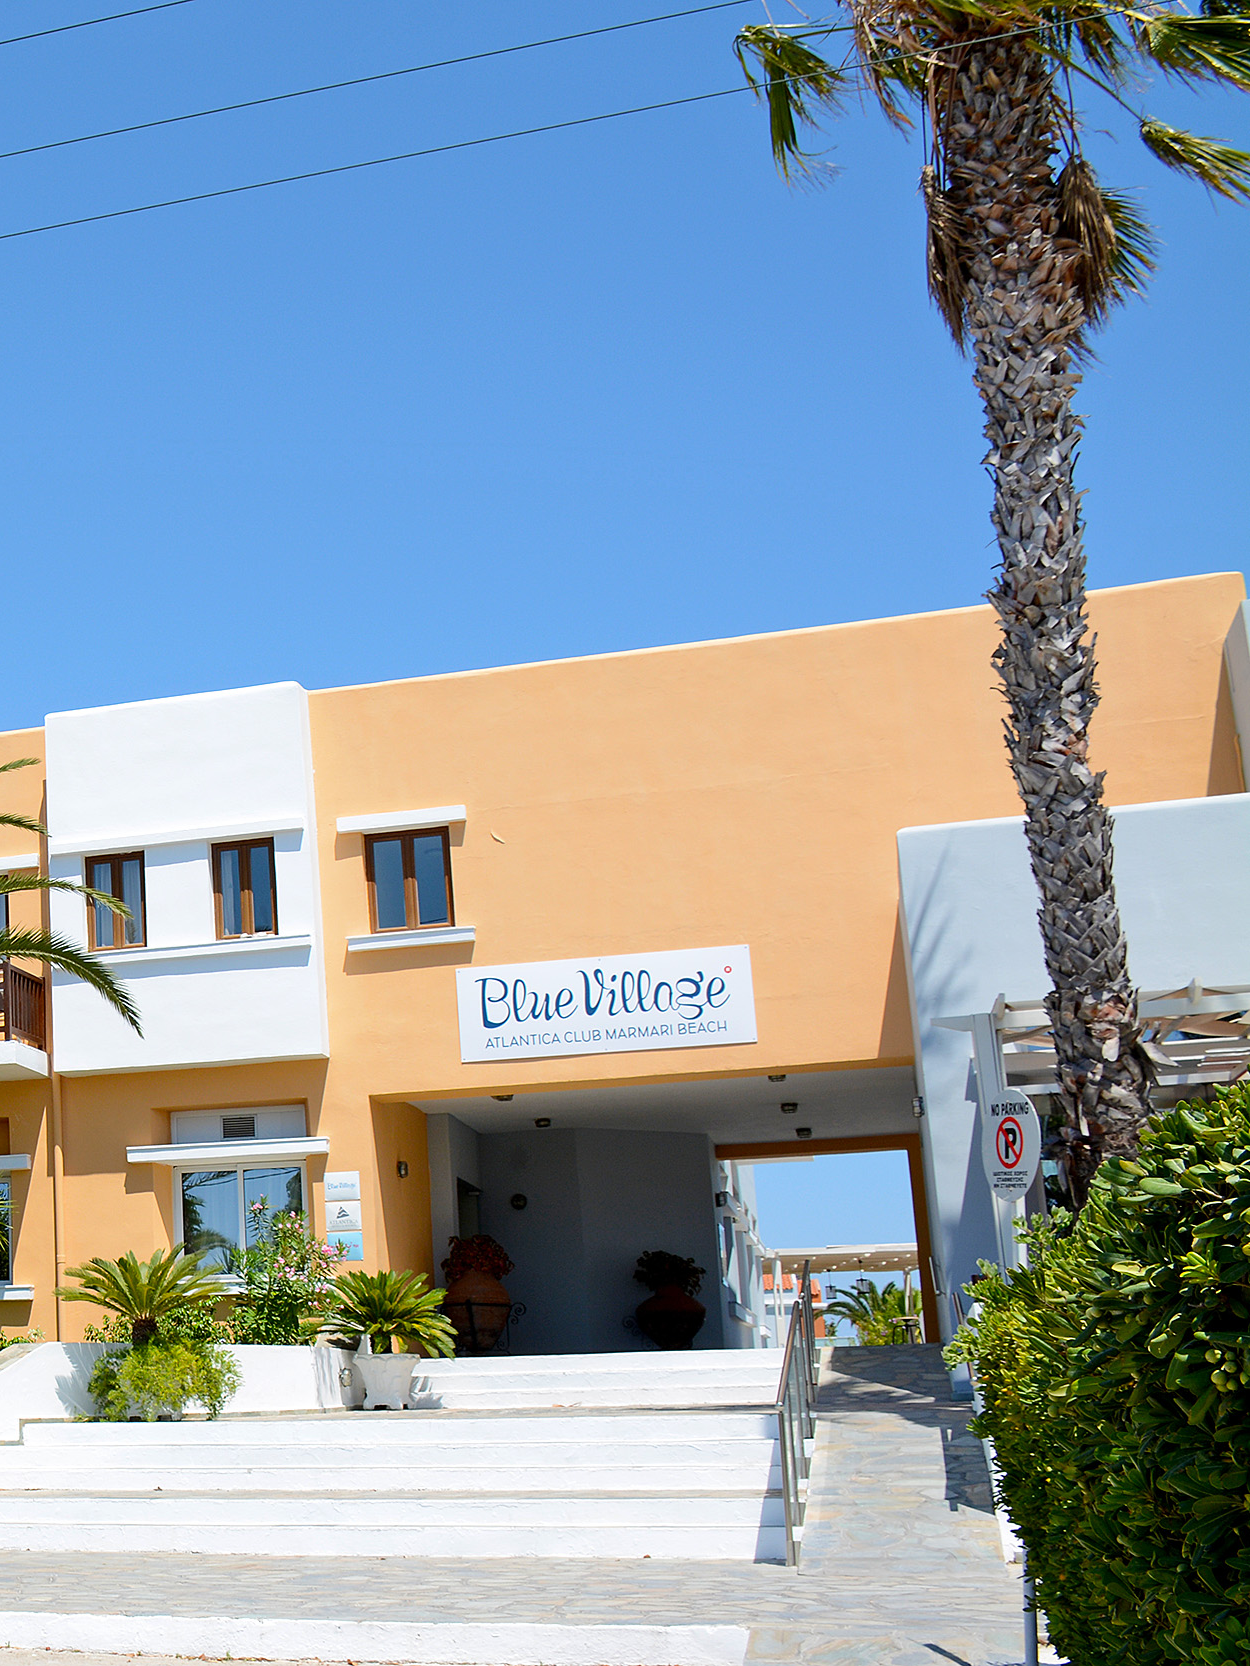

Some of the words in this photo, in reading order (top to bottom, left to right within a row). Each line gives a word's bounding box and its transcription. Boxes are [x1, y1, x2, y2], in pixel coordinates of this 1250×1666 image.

[475, 977, 579, 1029] Blue
[576, 968, 731, 1020] Village
[485, 1032, 562, 1050] ATLANTICA
[563, 1029, 602, 1044] CLUB
[605, 1024, 674, 1041] MARMARI
[677, 1020, 728, 1036] BEACH
[991, 1103, 1000, 1117] NO
[1001, 1101, 1029, 1116] PARKING
